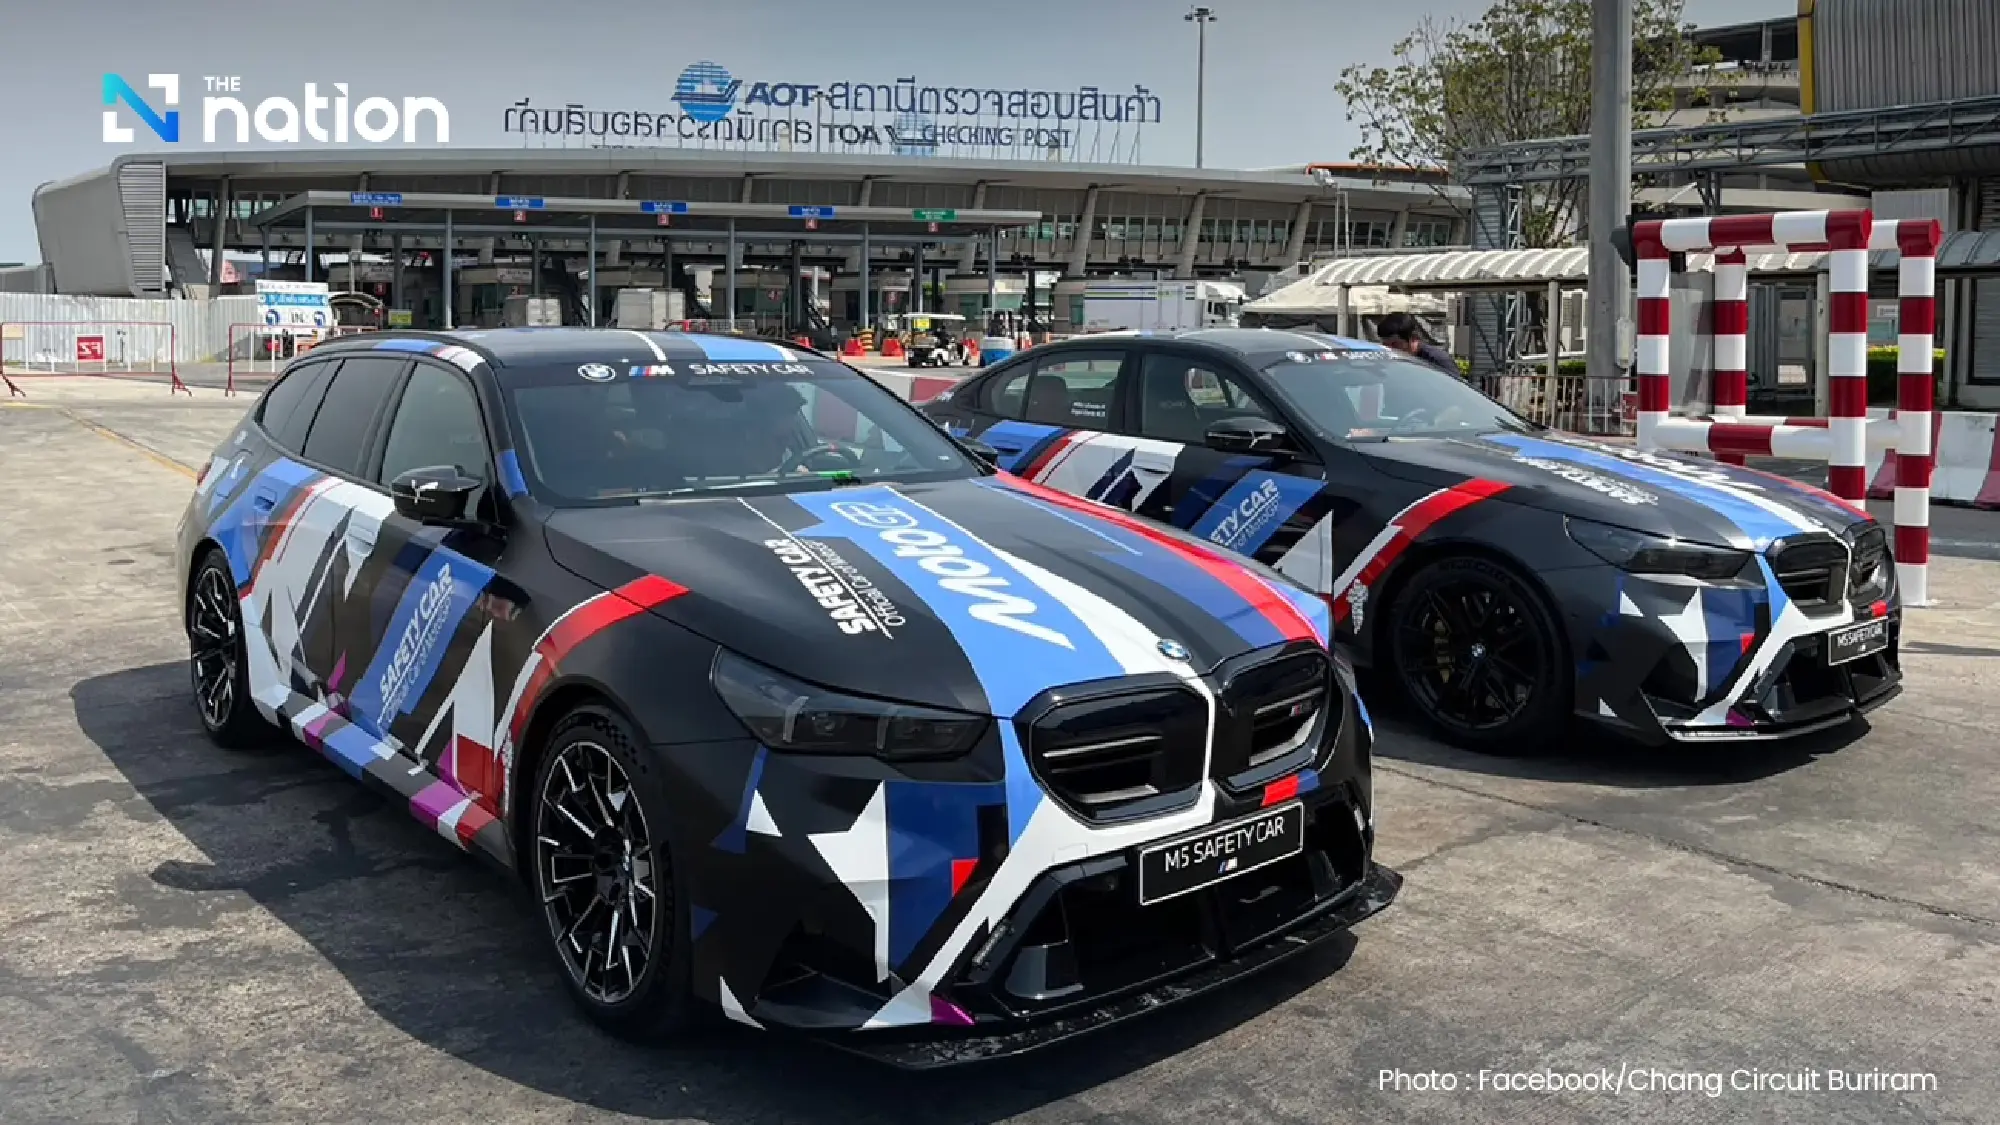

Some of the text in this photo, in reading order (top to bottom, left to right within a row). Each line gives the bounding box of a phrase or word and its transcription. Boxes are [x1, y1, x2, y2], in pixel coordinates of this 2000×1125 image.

[746, 75, 1161, 123] AOT สถานีตรวจสอบสินค้า
[922, 125, 1070, 149] CHECKING POST
[689, 363, 768, 375] SAFETY
[772, 363, 814, 376] CAR
[1240, 479, 1278, 517] CAR
[764, 539, 877, 634] SAFETY CAR
[831, 502, 1075, 650] MotoGP
[380, 563, 452, 702] SAFETY CAR
[1165, 816, 1285, 873] M5 SAFETY CAR
